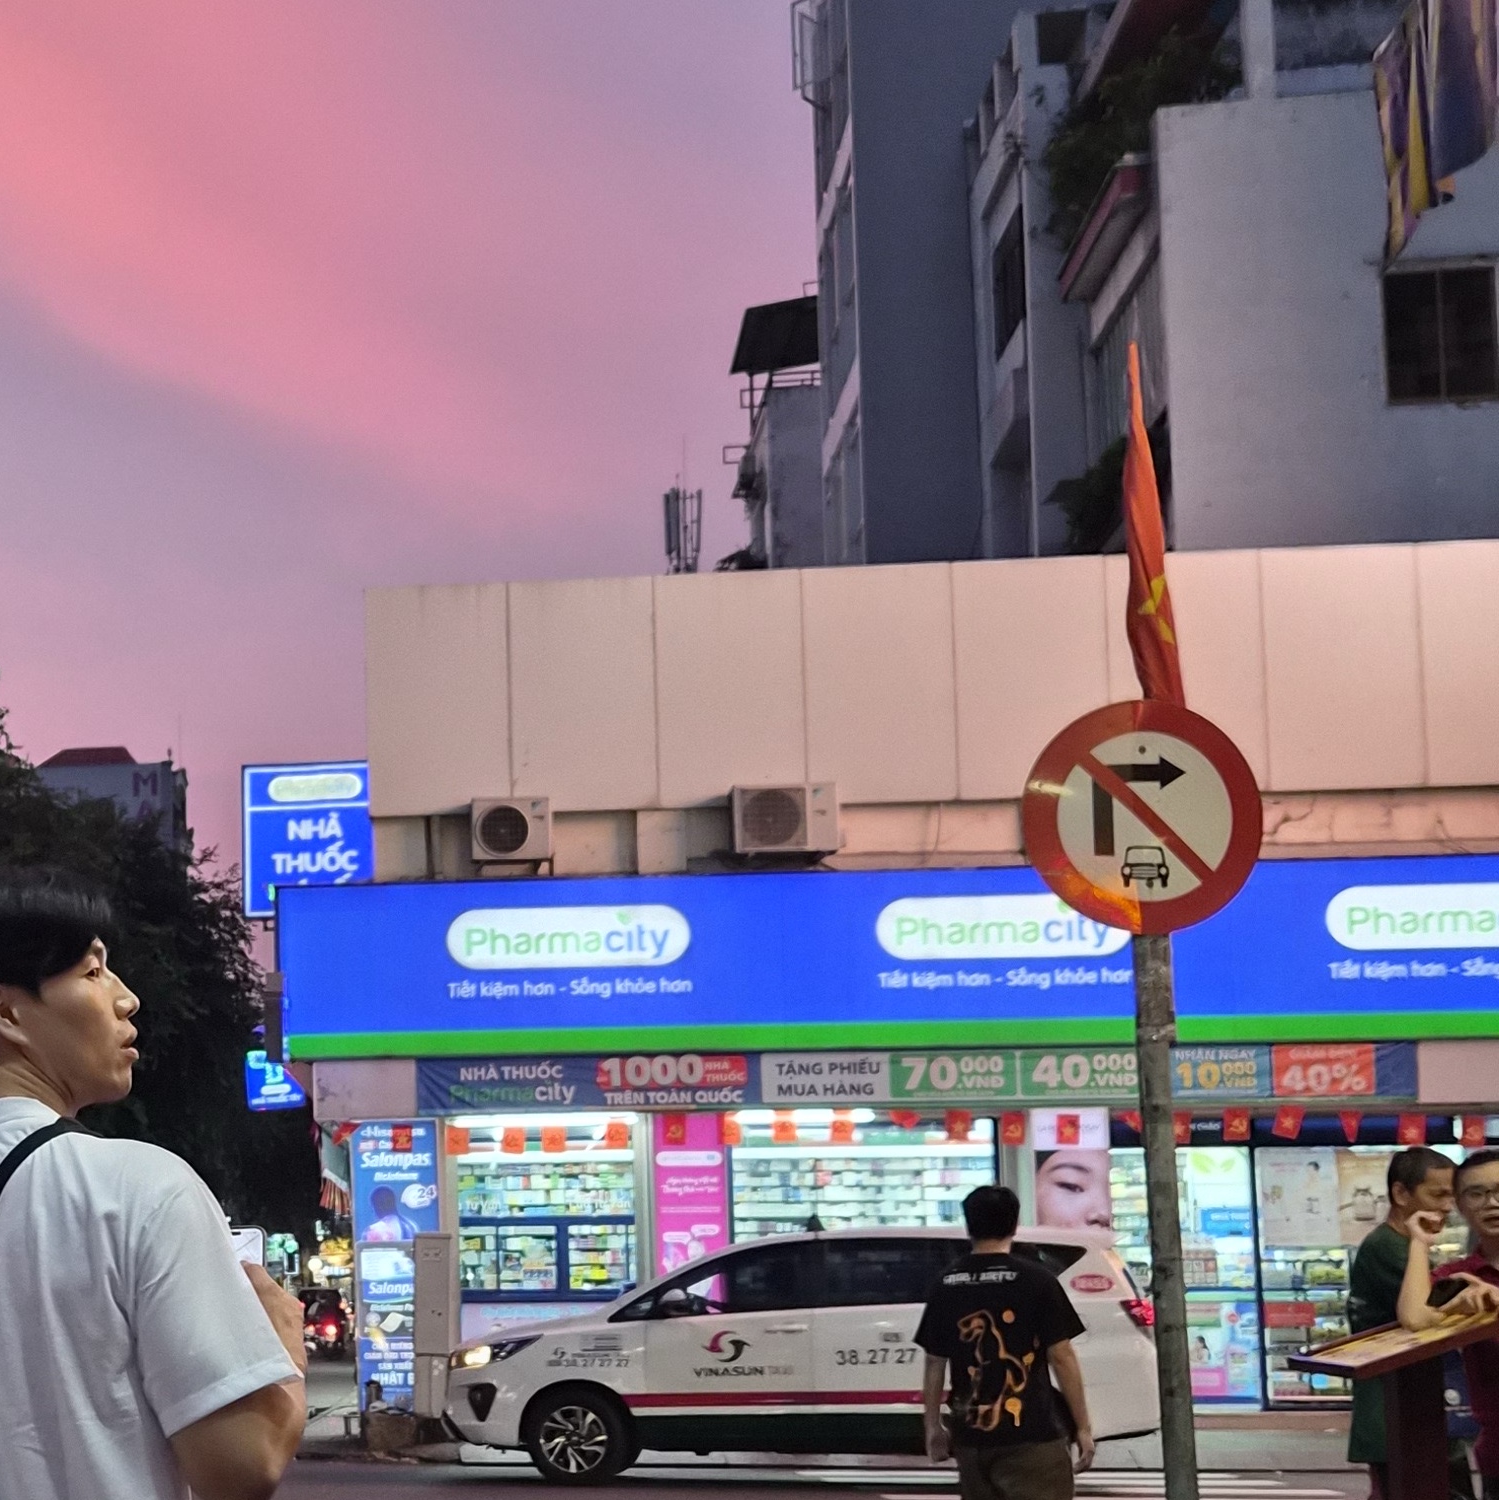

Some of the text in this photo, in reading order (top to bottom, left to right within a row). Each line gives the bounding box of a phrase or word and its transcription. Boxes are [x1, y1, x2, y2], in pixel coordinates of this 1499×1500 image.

[271, 841, 359, 874] THUỐC
[893, 903, 1109, 948] Pharmacity
[1346, 906, 1499, 935] Pharma
[463, 914, 670, 959] Pharmacity
[447, 980, 476, 998] Tiết
[480, 981, 518, 999] kiệm
[523, 981, 555, 996] hơn
[570, 976, 612, 998] Sống
[660, 977, 693, 993] hơn
[460, 1060, 563, 1080] NHÀ THUỐC
[601, 1054, 704, 1087] 1000
[775, 1057, 880, 1080] TẶNG PHIẾU
[1282, 1063, 1367, 1092] 40%
[604, 1085, 745, 1105] TRÊN TOÀN QUỐC
[777, 1080, 875, 1096] MUA HÀNG
[361, 1152, 432, 1169] Salonpas
[417, 1187, 435, 1199] 24
[368, 1282, 414, 1296] Salonpa
[693, 1365, 764, 1378] VINASUN
